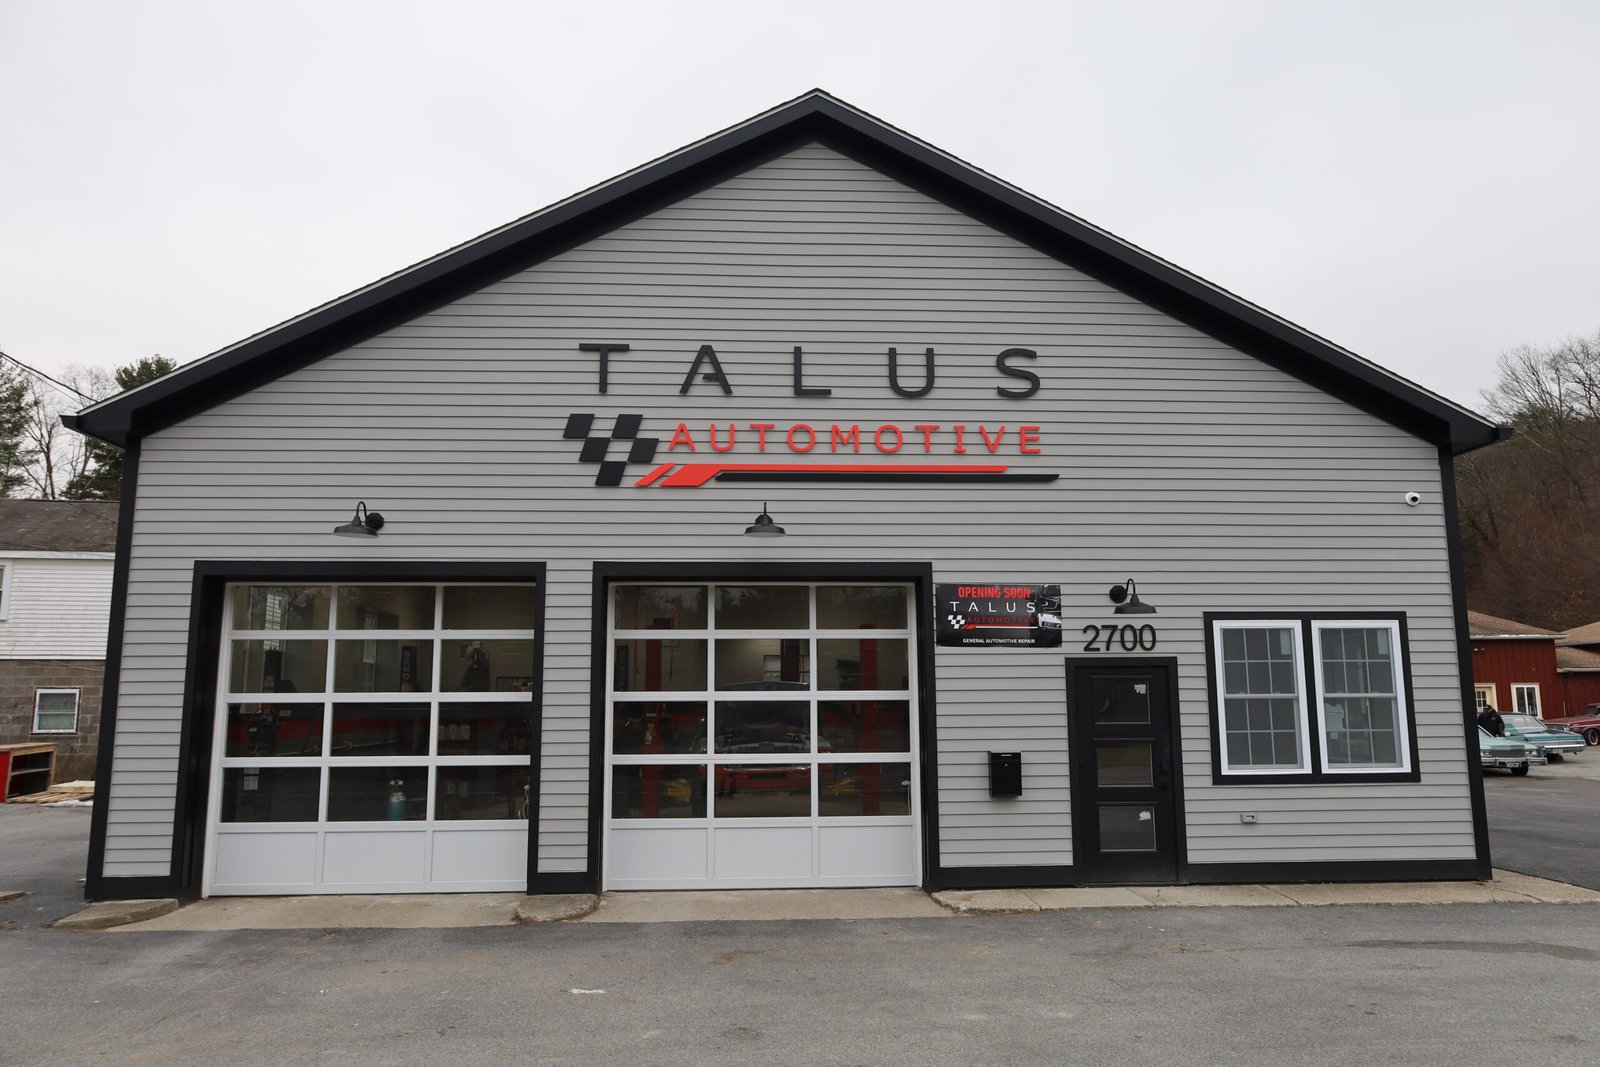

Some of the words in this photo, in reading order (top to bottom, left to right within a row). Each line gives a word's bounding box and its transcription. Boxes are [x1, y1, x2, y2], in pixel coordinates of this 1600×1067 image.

[579, 343, 1041, 398] TALUS
[668, 423, 1041, 454] AUTOMOTIVE
[958, 586, 1001, 598] OPENING
[1004, 586, 1031, 598] SOON
[949, 601, 1036, 613] TALUS
[966, 616, 1037, 624] AUTOMOTIVE
[1082, 624, 1157, 652] 2700
